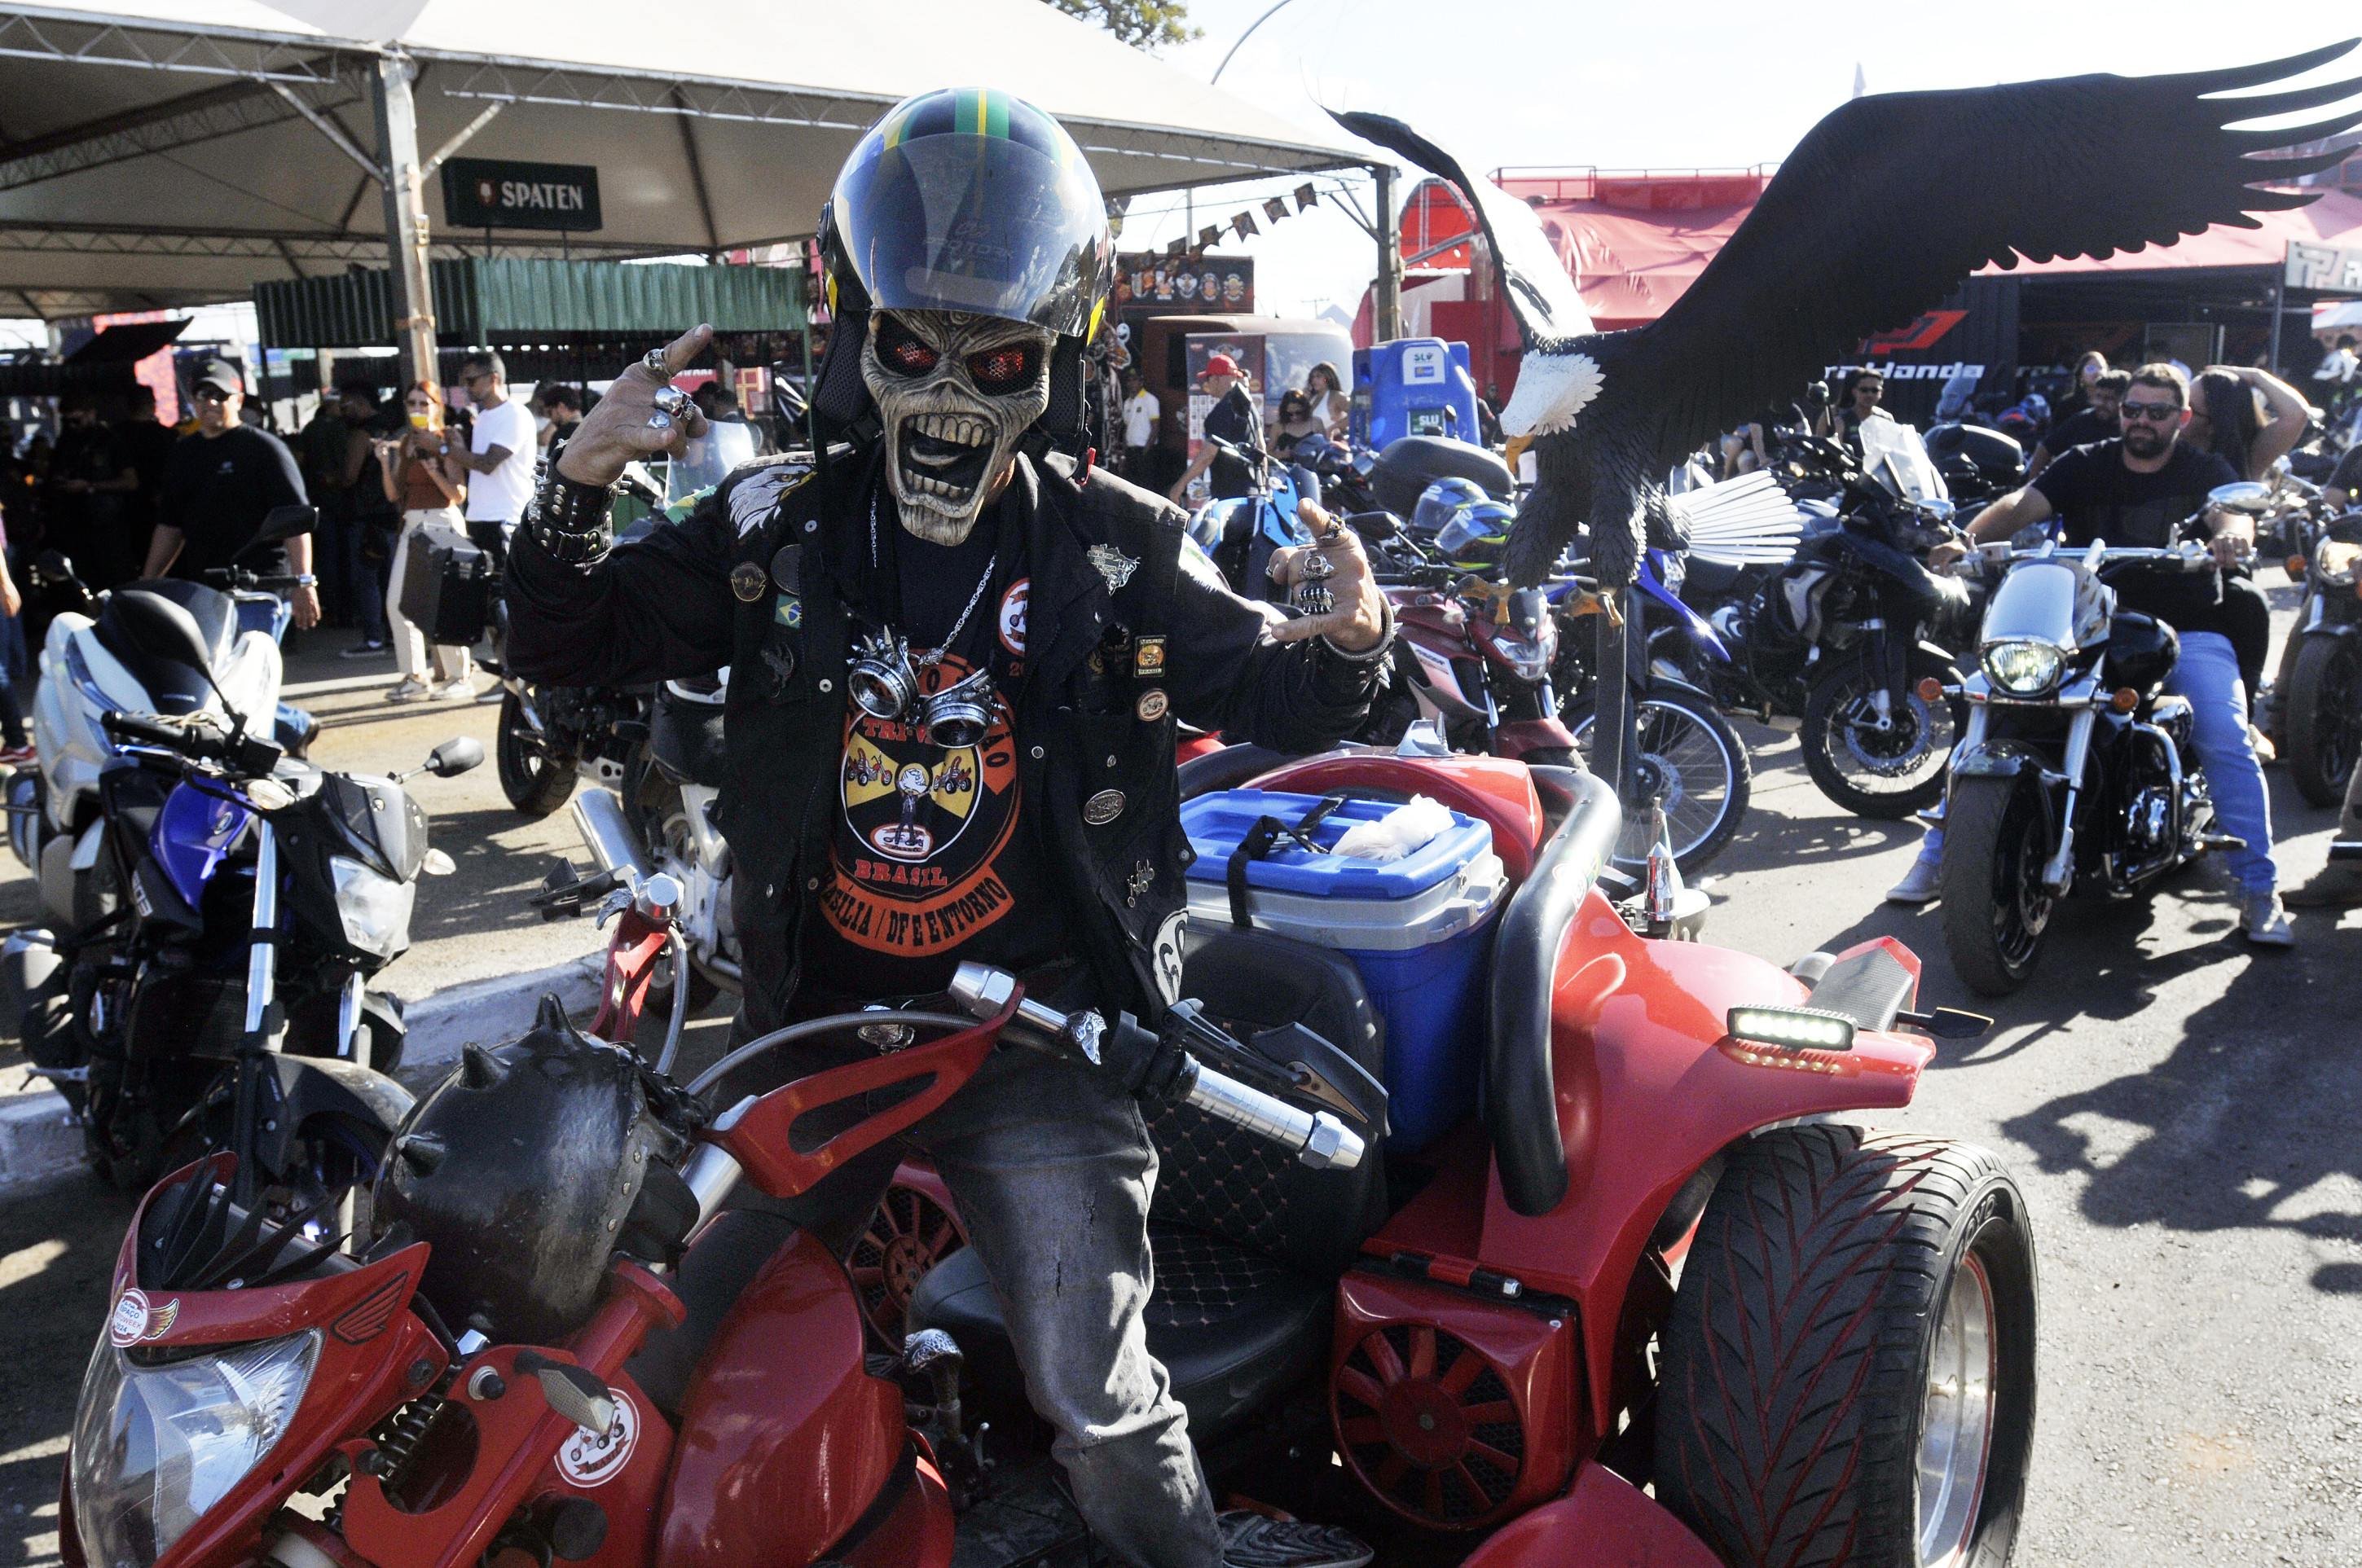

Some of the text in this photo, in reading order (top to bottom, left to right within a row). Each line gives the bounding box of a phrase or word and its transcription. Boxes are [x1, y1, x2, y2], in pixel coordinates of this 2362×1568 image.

[501, 181, 583, 210] SPATEN
[1419, 415, 1439, 426] SLU
[855, 859, 948, 887] BRASIL
[886, 910, 910, 946] DF
[912, 914, 925, 947] E
[924, 876, 1008, 945] ENTORNO
